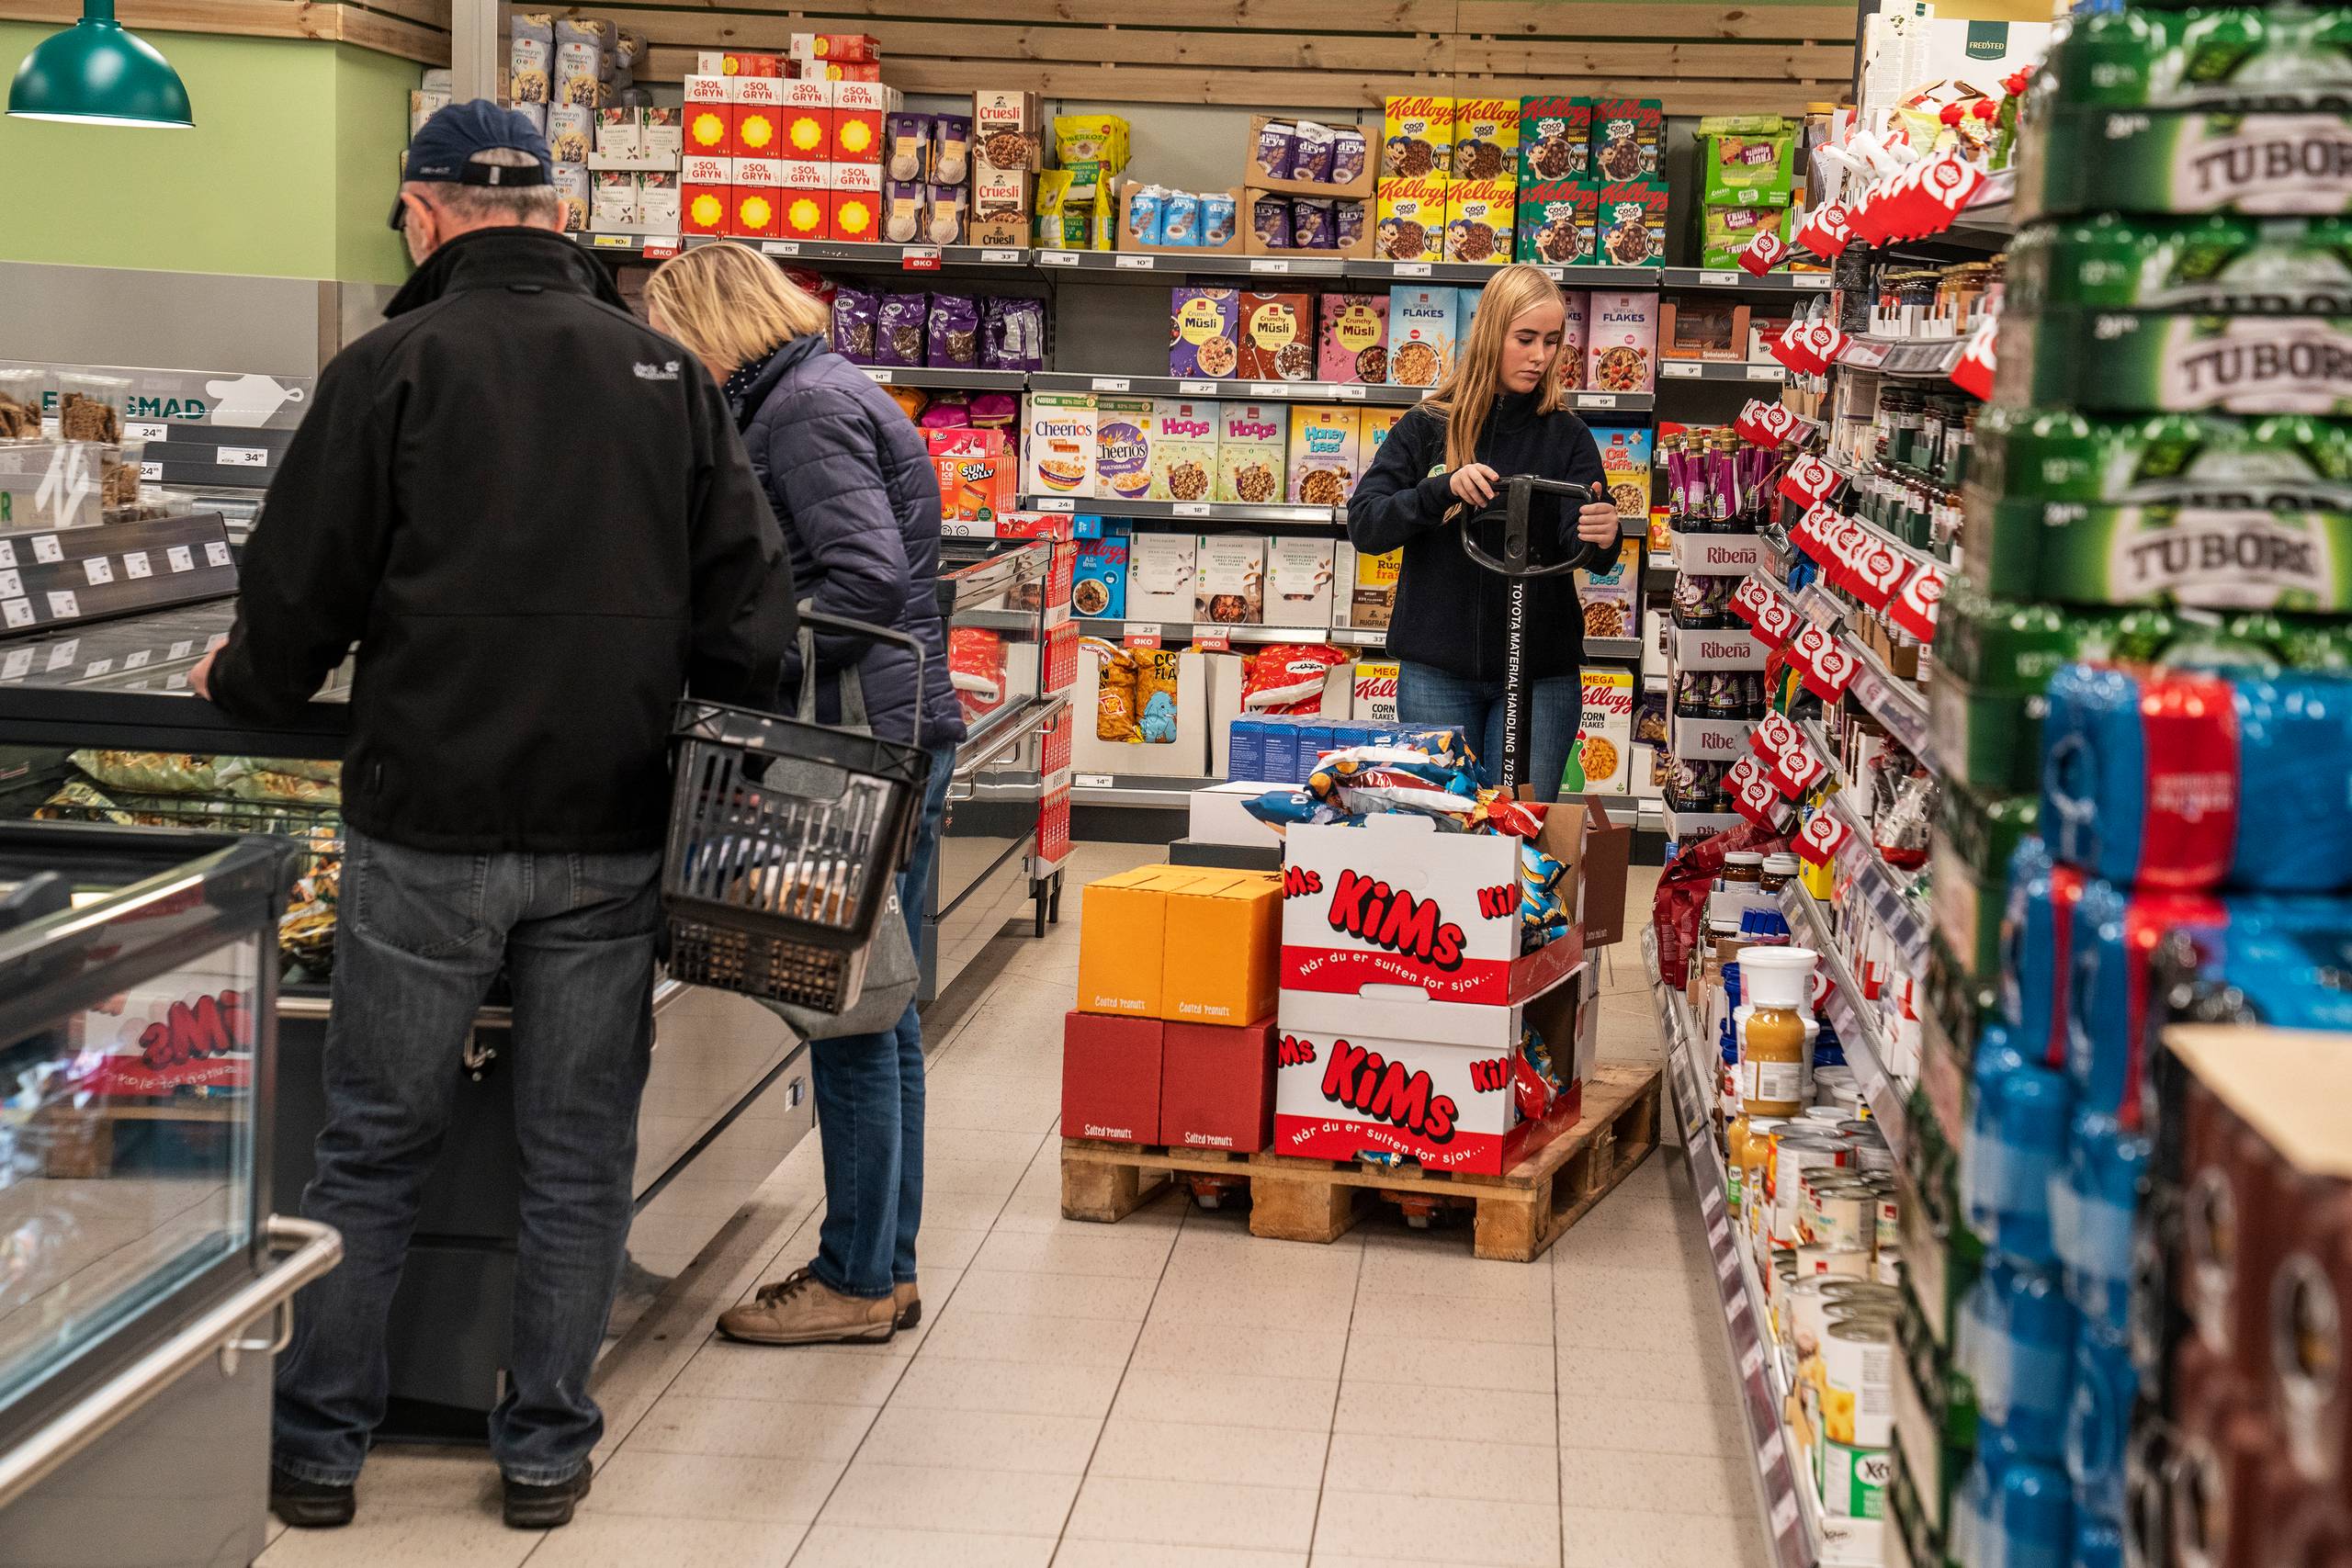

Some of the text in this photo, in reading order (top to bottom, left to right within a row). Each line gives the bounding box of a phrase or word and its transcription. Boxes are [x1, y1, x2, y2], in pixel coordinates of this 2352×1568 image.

[1970, 41, 2004, 50] FREDSTED
[701, 80, 720, 88] SOL
[752, 82, 769, 90] SOL
[799, 85, 819, 93] SOL
[694, 89, 723, 97] GRYN
[743, 91, 772, 99] GRYN
[850, 86, 869, 96] SOL
[792, 93, 821, 101] GRYN
[842, 96, 871, 104] GRYN
[979, 107, 1020, 119] Cruesli
[1404, 122, 1424, 130] COCO
[1474, 126, 1494, 134] COCO
[1541, 121, 1562, 130] COCO
[1611, 123, 1631, 131] COCO
[1299, 142, 1326, 153] drys
[1338, 141, 1365, 153] drys
[698, 162, 718, 170] SOL
[749, 164, 768, 172] SOL
[797, 165, 817, 175] SOL
[693, 170, 721, 178] GRYN
[742, 173, 771, 181] GRYN
[848, 168, 867, 177] SOL
[791, 175, 820, 184] GRYN
[841, 176, 869, 186] GRYN
[979, 186, 1019, 198] Cruesli
[1396, 203, 1417, 211] COCO
[1465, 204, 1486, 213] COCO
[1618, 208, 1638, 216] COCO
[1726, 210, 1750, 220] FRUIT
[983, 235, 1014, 245] Cruesli
[1260, 315, 1287, 323] Crunchy
[1402, 309, 1444, 319] FLAKES
[1185, 317, 1216, 329] Müsli
[1345, 317, 1372, 325] Crunchy
[1257, 321, 1289, 333] Müsli
[1342, 324, 1374, 336] Müsli
[1035, 420, 1092, 436] Cheerios
[1161, 418, 1210, 438] Hoops
[1228, 421, 1277, 440] Hoops
[1305, 426, 1347, 443] Honey
[1310, 440, 1340, 453] bees
[1605, 446, 1628, 458] Oat
[940, 461, 954, 471] 10
[962, 462, 985, 477] SUN
[967, 467, 994, 481] LOLLY
[1707, 546, 1757, 564] Ribena
[1377, 560, 1400, 571] Rug
[1589, 572, 1620, 585] bees
[1510, 584, 1522, 630] TOYOTA
[1701, 641, 1750, 659] Ribena
[1508, 632, 1521, 690] MATERIAL
[1583, 675, 1615, 684] MEGA
[1581, 686, 1632, 715] ellogg
[1372, 704, 1396, 714] CORN
[1372, 713, 1395, 721] FLAKES
[1582, 712, 1605, 722] CORN
[1505, 693, 1518, 753] HANDLING
[1702, 732, 1736, 750] Ribe
[1504, 759, 1514, 772] 70
[1328, 868, 1467, 972] KiMs
[1298, 958, 1323, 976] Når
[1329, 951, 1347, 963] du
[1352, 953, 1369, 963] er
[1374, 955, 1417, 982] sulten
[1422, 975, 1444, 990] for
[1094, 995, 1146, 1010] Coated Peanuts
[1179, 1001, 1230, 1017] Coated Peanuts
[1321, 1039, 1459, 1145] KiMs
[1084, 1123, 1132, 1139] Salted Peanuts
[1184, 1131, 1233, 1147] Salted Peanuts
[1292, 1127, 1317, 1146] Når
[1322, 1121, 1340, 1134] du
[1345, 1122, 1362, 1133] er
[1366, 1126, 1409, 1155] sulten
[1414, 1147, 1436, 1162] for
